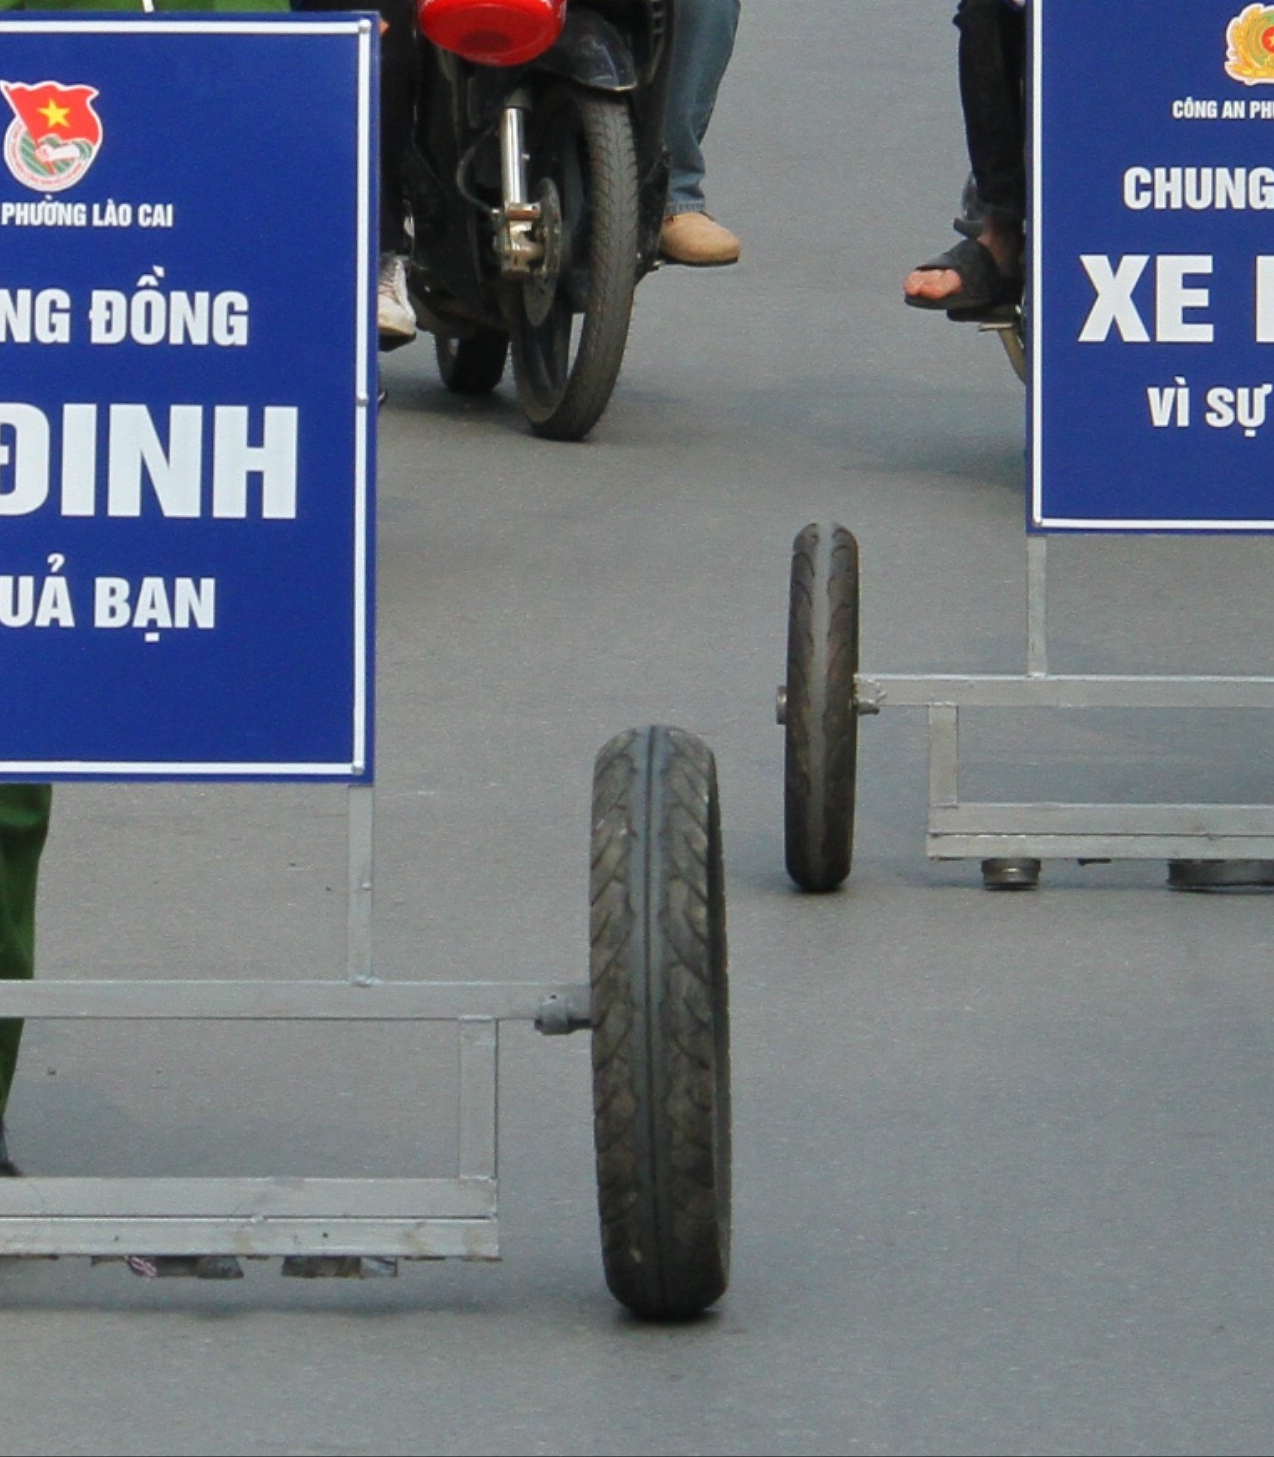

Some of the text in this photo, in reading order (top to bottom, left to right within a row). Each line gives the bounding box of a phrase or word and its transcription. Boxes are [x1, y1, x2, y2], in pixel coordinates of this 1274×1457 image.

[1173, 97, 1217, 118] CÔNG
[1222, 101, 1245, 118] AN
[1, 194, 86, 226] PHƯỜNG
[92, 199, 132, 227] LÀO
[138, 204, 173, 227] CAI
[89, 266, 248, 346] ĐỒNG
[1078, 255, 1213, 342] XE
[1147, 377, 1189, 427] VÌ
[1206, 384, 1272, 437] SỰ
[94, 577, 215, 642] BẠN
